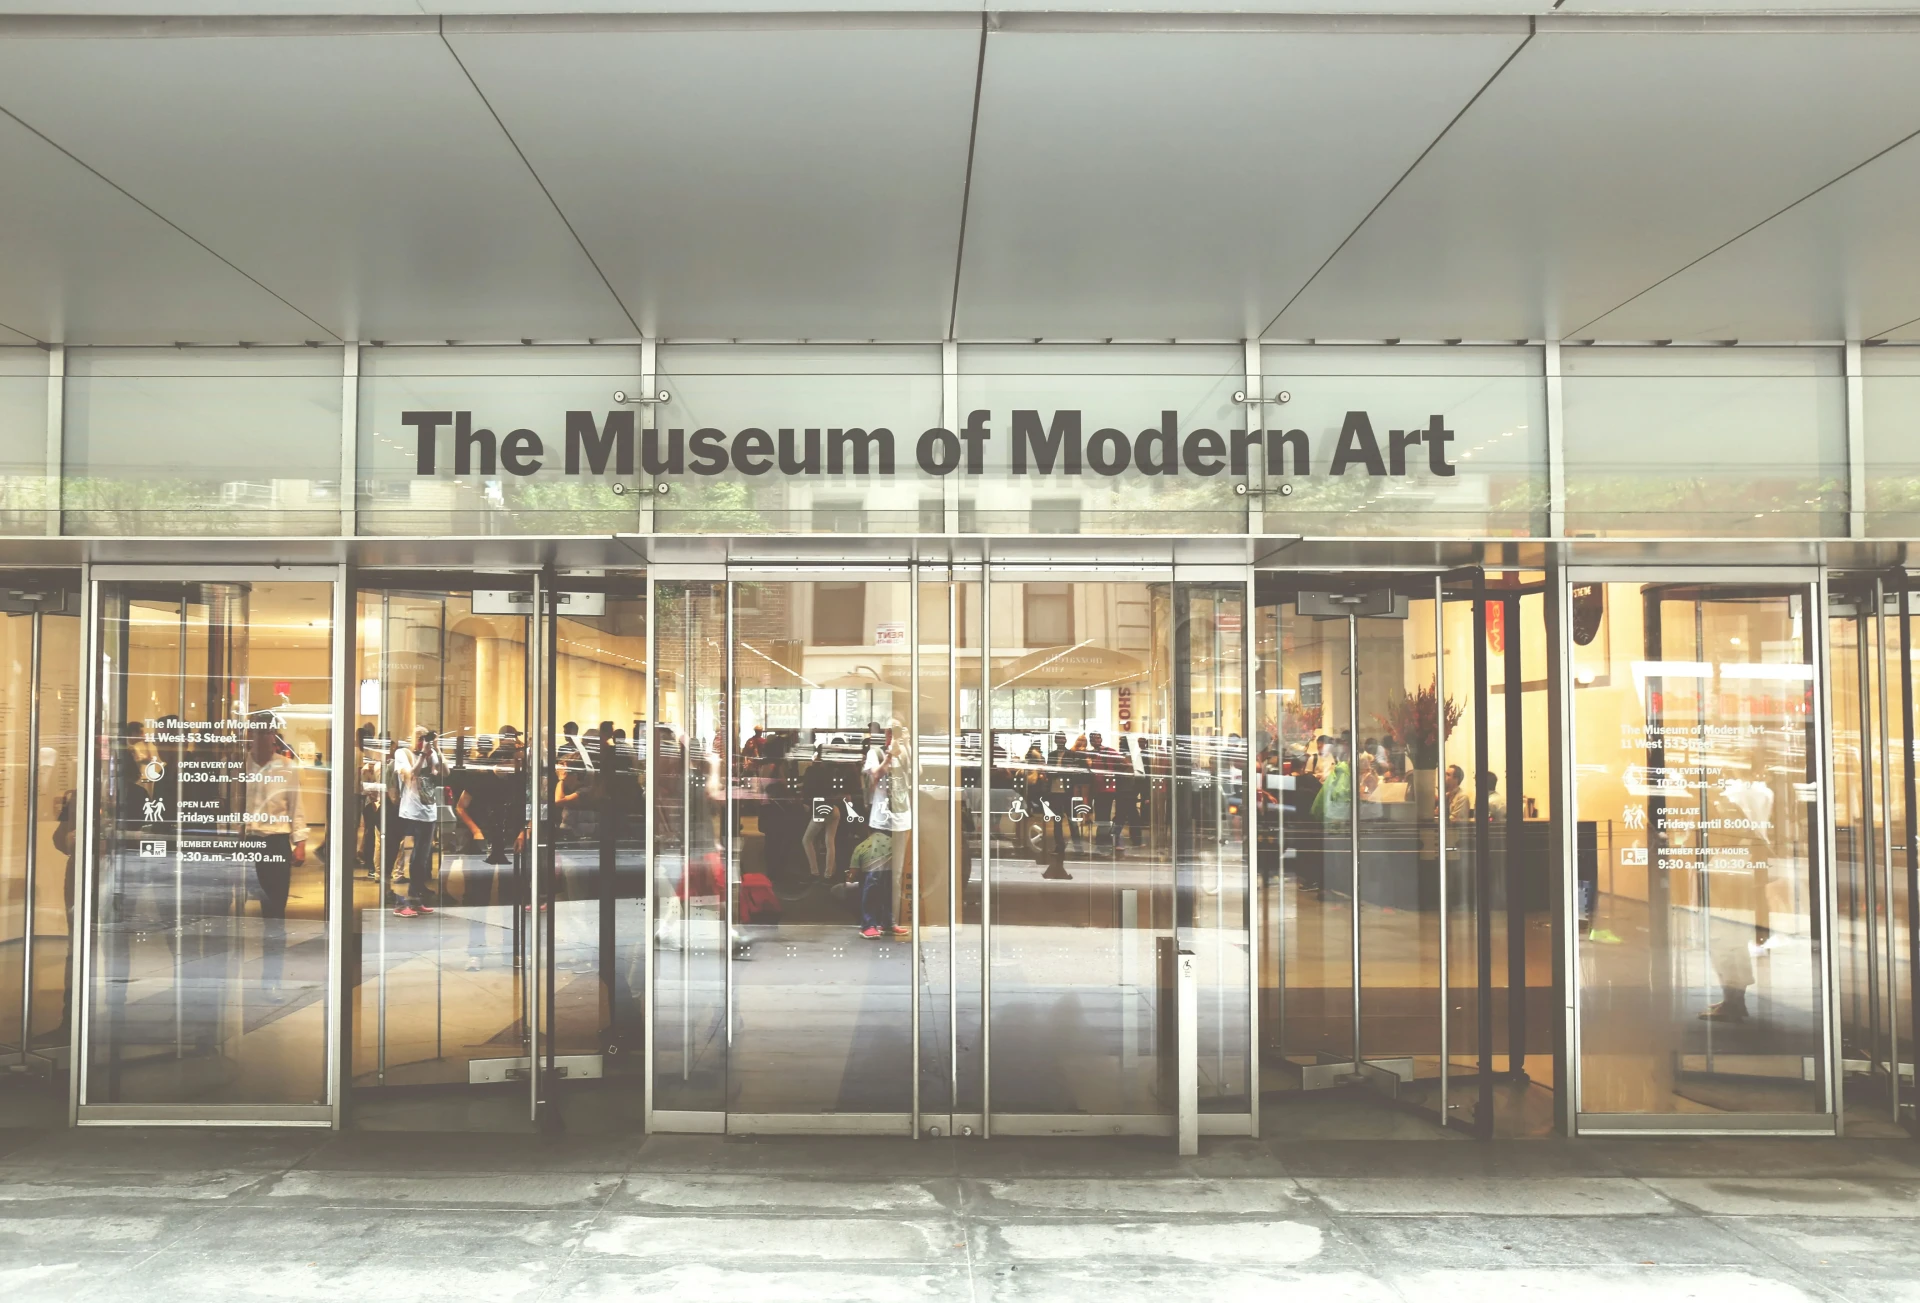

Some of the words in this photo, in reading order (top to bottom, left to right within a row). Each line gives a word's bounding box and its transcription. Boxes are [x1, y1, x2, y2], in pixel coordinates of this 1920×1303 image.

[401, 410, 544, 477] The
[565, 410, 896, 477] Museum
[916, 409, 992, 477] of
[1011, 409, 1311, 477] Modern
[1329, 410, 1456, 477] Art
[1118, 687, 1131, 731] SHOP
[144, 718, 165, 730] The
[166, 718, 212, 730] Museum
[214, 718, 225, 730] of
[226, 719, 268, 730] Modern
[269, 719, 287, 730] Art
[1621, 724, 1640, 735] The
[1643, 724, 1689, 735] Museum
[1690, 724, 1702, 735] of
[1703, 724, 1744, 735] Modern
[1747, 724, 1765, 735] Art
[158, 733, 186, 743] West
[187, 733, 202, 743] 53
[204, 733, 237, 743] Street
[1634, 739, 1663, 749] West
[1664, 739, 1679, 749] 53
[177, 761, 200, 769] OPEN
[200, 761, 227, 769] EVERY
[228, 761, 244, 769] DAY
[177, 773, 209, 783] 10:30
[264, 775, 287, 784] p.m.
[177, 812, 215, 824] Fridays
[216, 812, 241, 822] until
[242, 813, 268, 823] 8:00
[269, 814, 292, 824] p.m.
[1657, 819, 1695, 830] Fridays
[1697, 819, 1722, 829] until
[1723, 819, 1749, 829] 8:00
[239, 841, 267, 849] HOURS
[263, 854, 286, 862] a.m.
[1657, 859, 1683, 869] 9:30
[1745, 861, 1769, 870] a.m.
